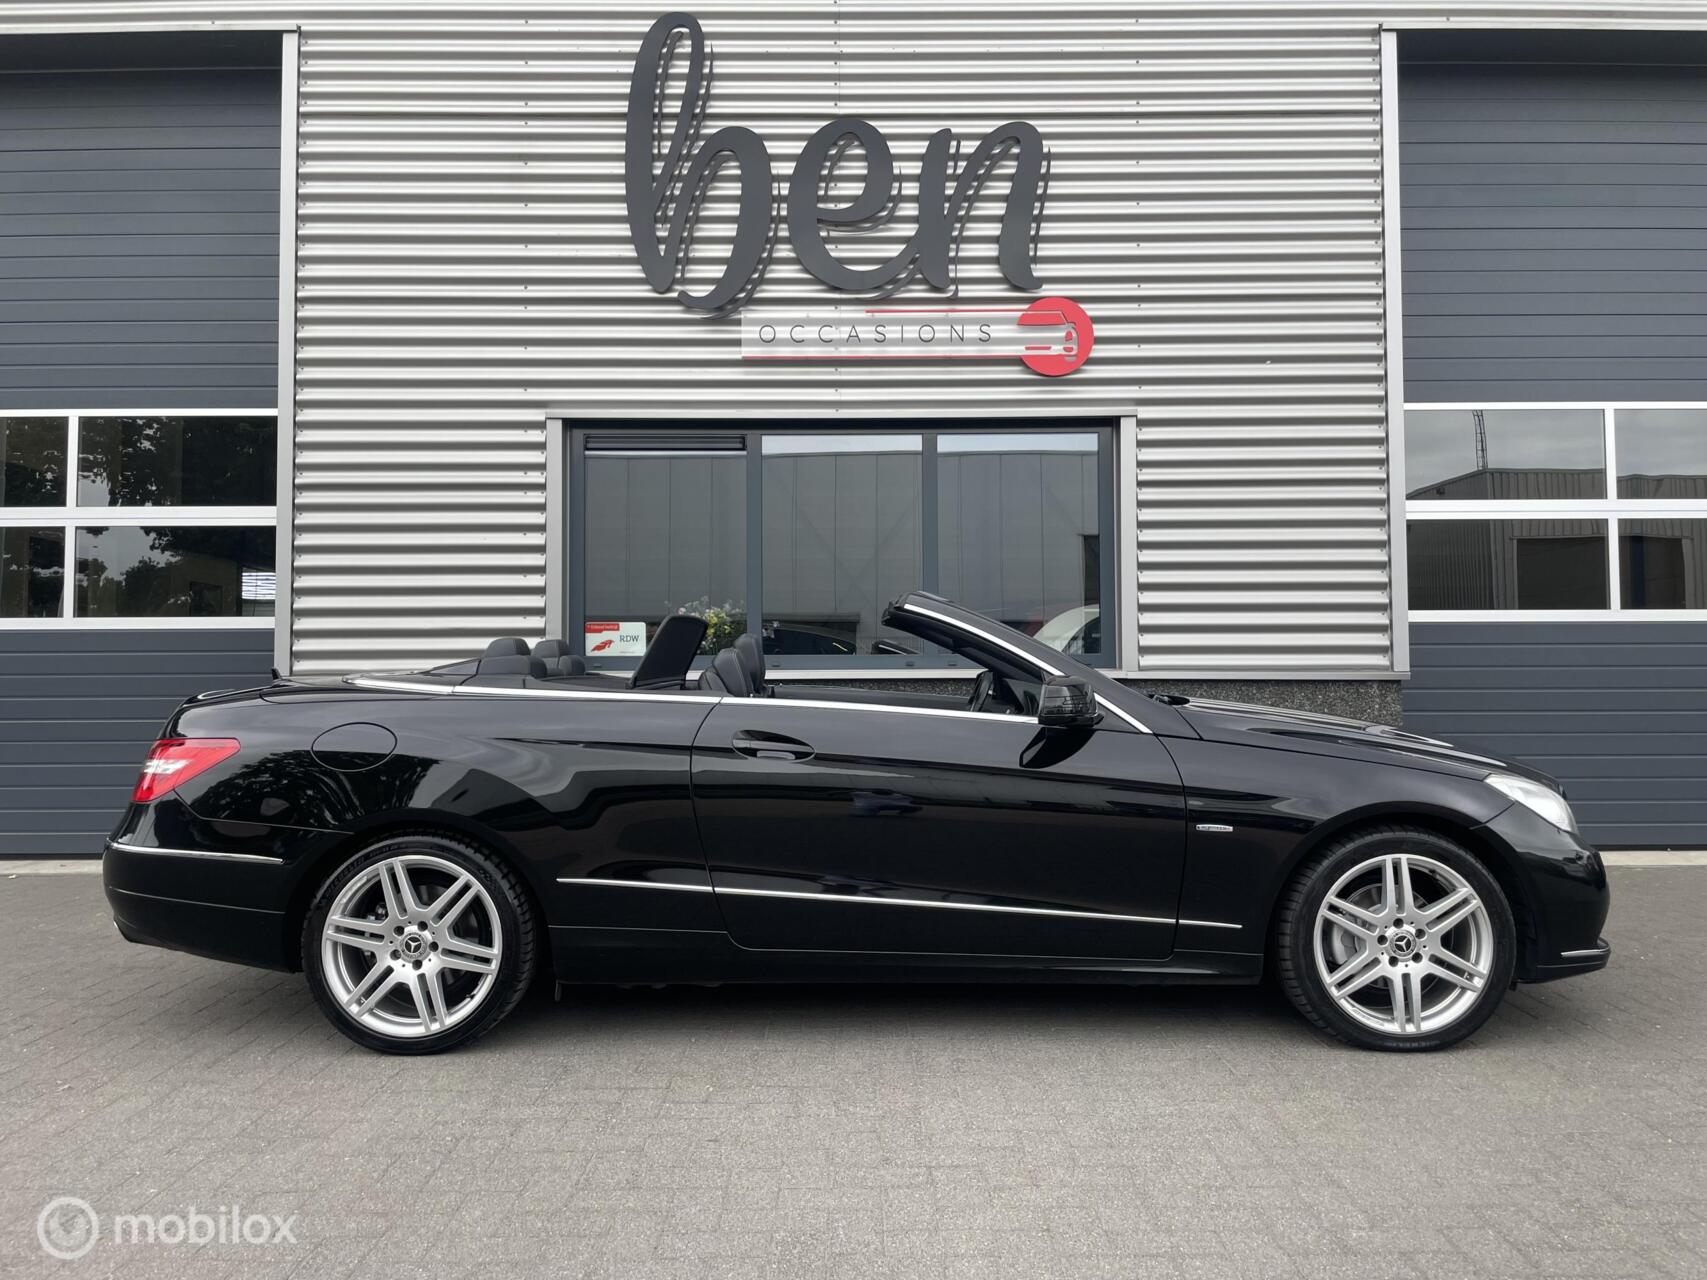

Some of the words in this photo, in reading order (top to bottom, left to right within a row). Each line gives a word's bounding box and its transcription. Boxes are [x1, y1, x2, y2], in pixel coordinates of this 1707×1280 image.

[625, 12, 1043, 309] ben
[758, 324, 992, 344] OCCASIONS
[619, 634, 640, 643] RDW
